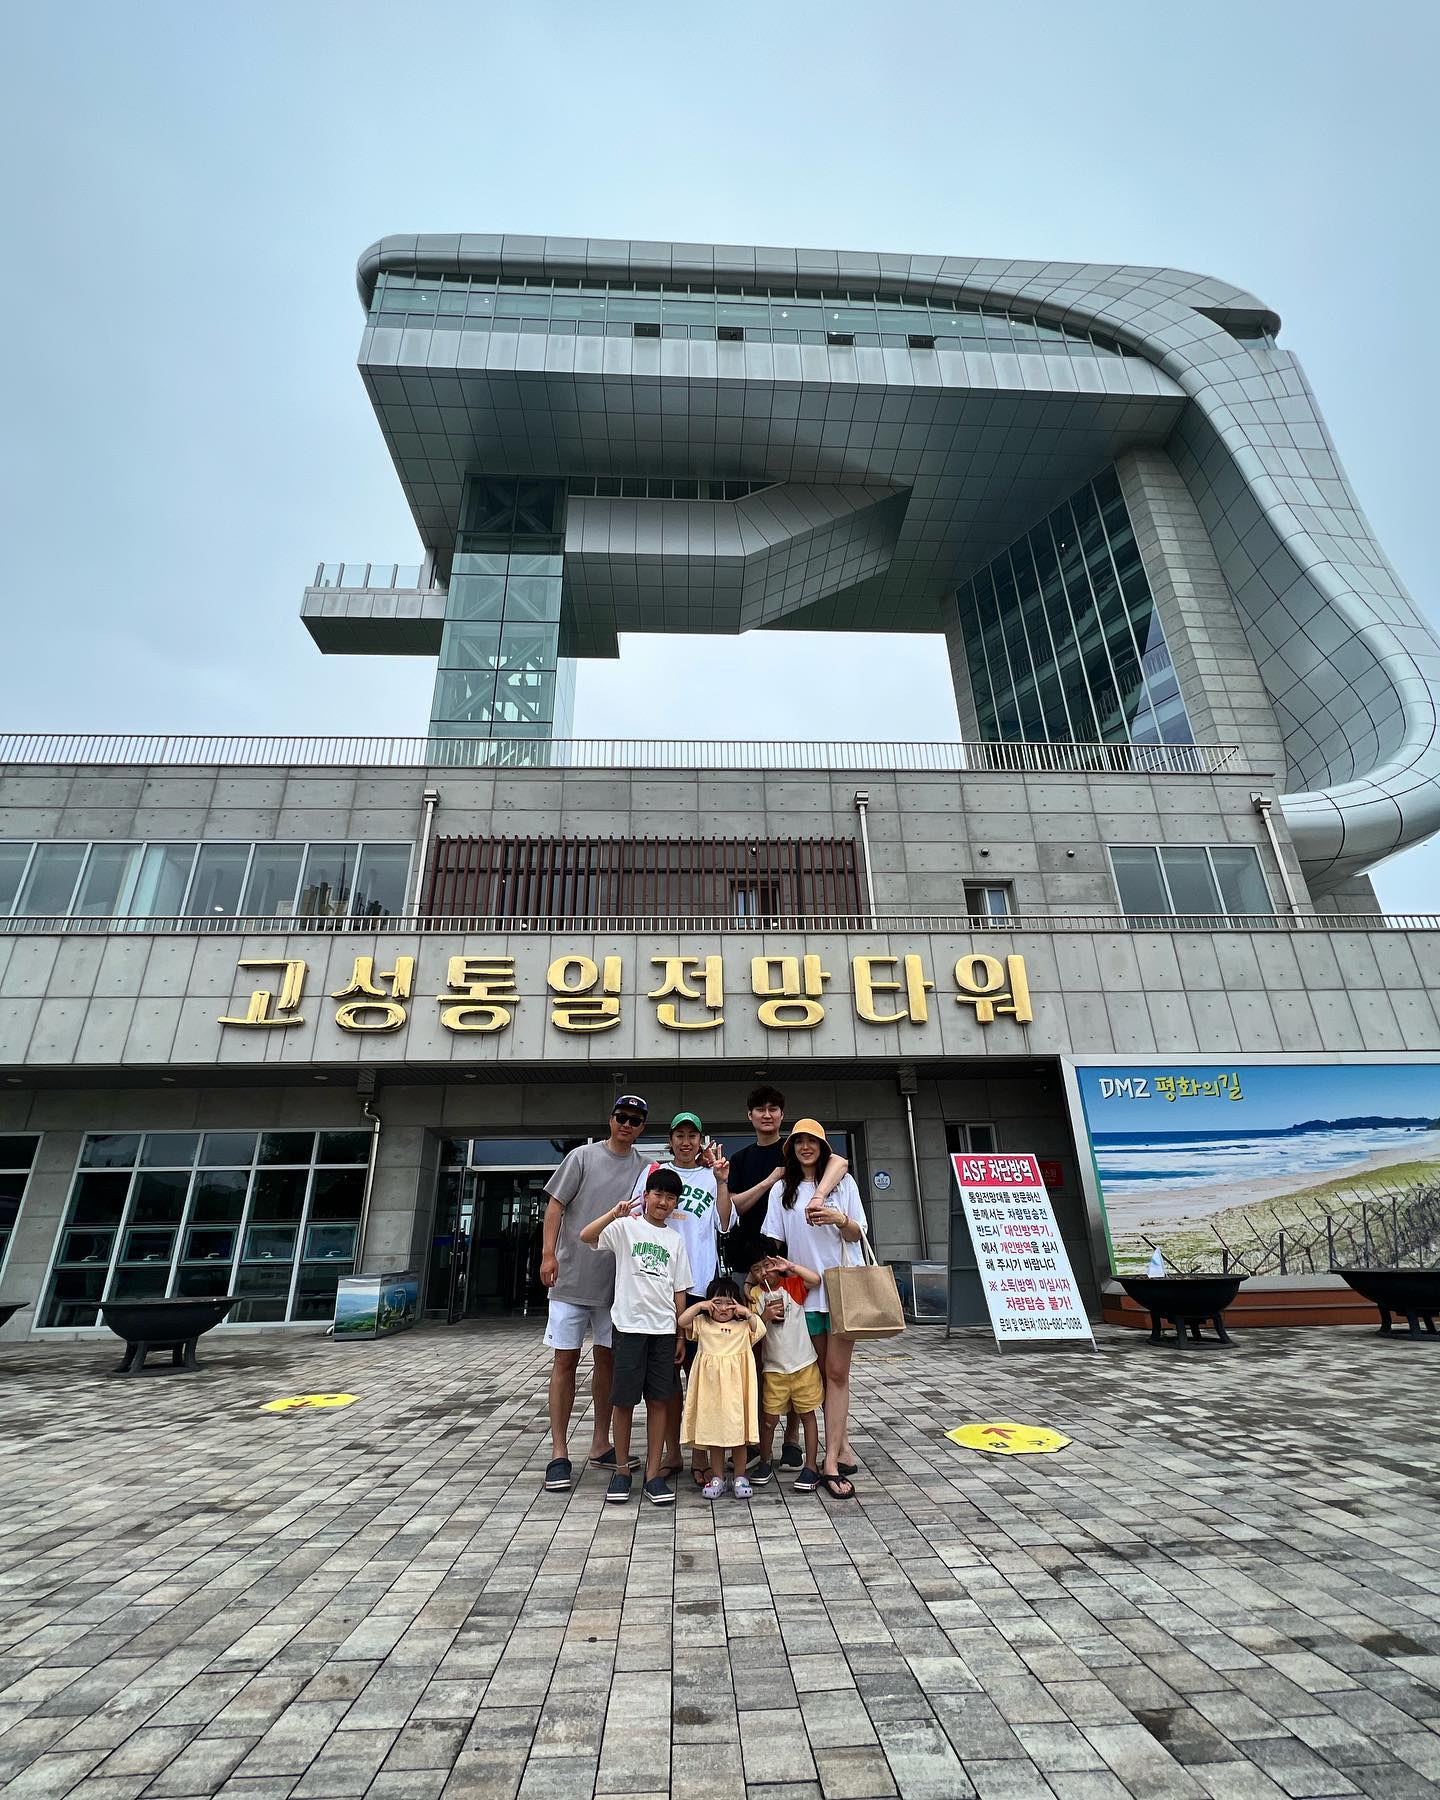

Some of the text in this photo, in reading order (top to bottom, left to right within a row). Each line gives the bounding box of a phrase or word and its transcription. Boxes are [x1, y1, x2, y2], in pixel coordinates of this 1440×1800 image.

[217, 953, 1033, 1034] 고성통일전망타워
[1099, 1077, 1151, 1099] DMZ
[962, 1159, 1035, 1182] ASF 차단방역
[968, 1192, 1042, 1204] 통일전망대를 방문하신
[972, 1208, 1048, 1220] 분께서는 차량탑승전
[976, 1224, 1000, 1237] 반드시
[981, 1241, 1059, 1254] 에서 개인방역을 실시
[985, 1258, 1056, 1271] 해 주시기 바랍니다
[1000, 1278, 1037, 1292] 소독(방역)
[1038, 1278, 1071, 1292] 미실시자
[1006, 1296, 1073, 1311] 차량탑승 불가!
